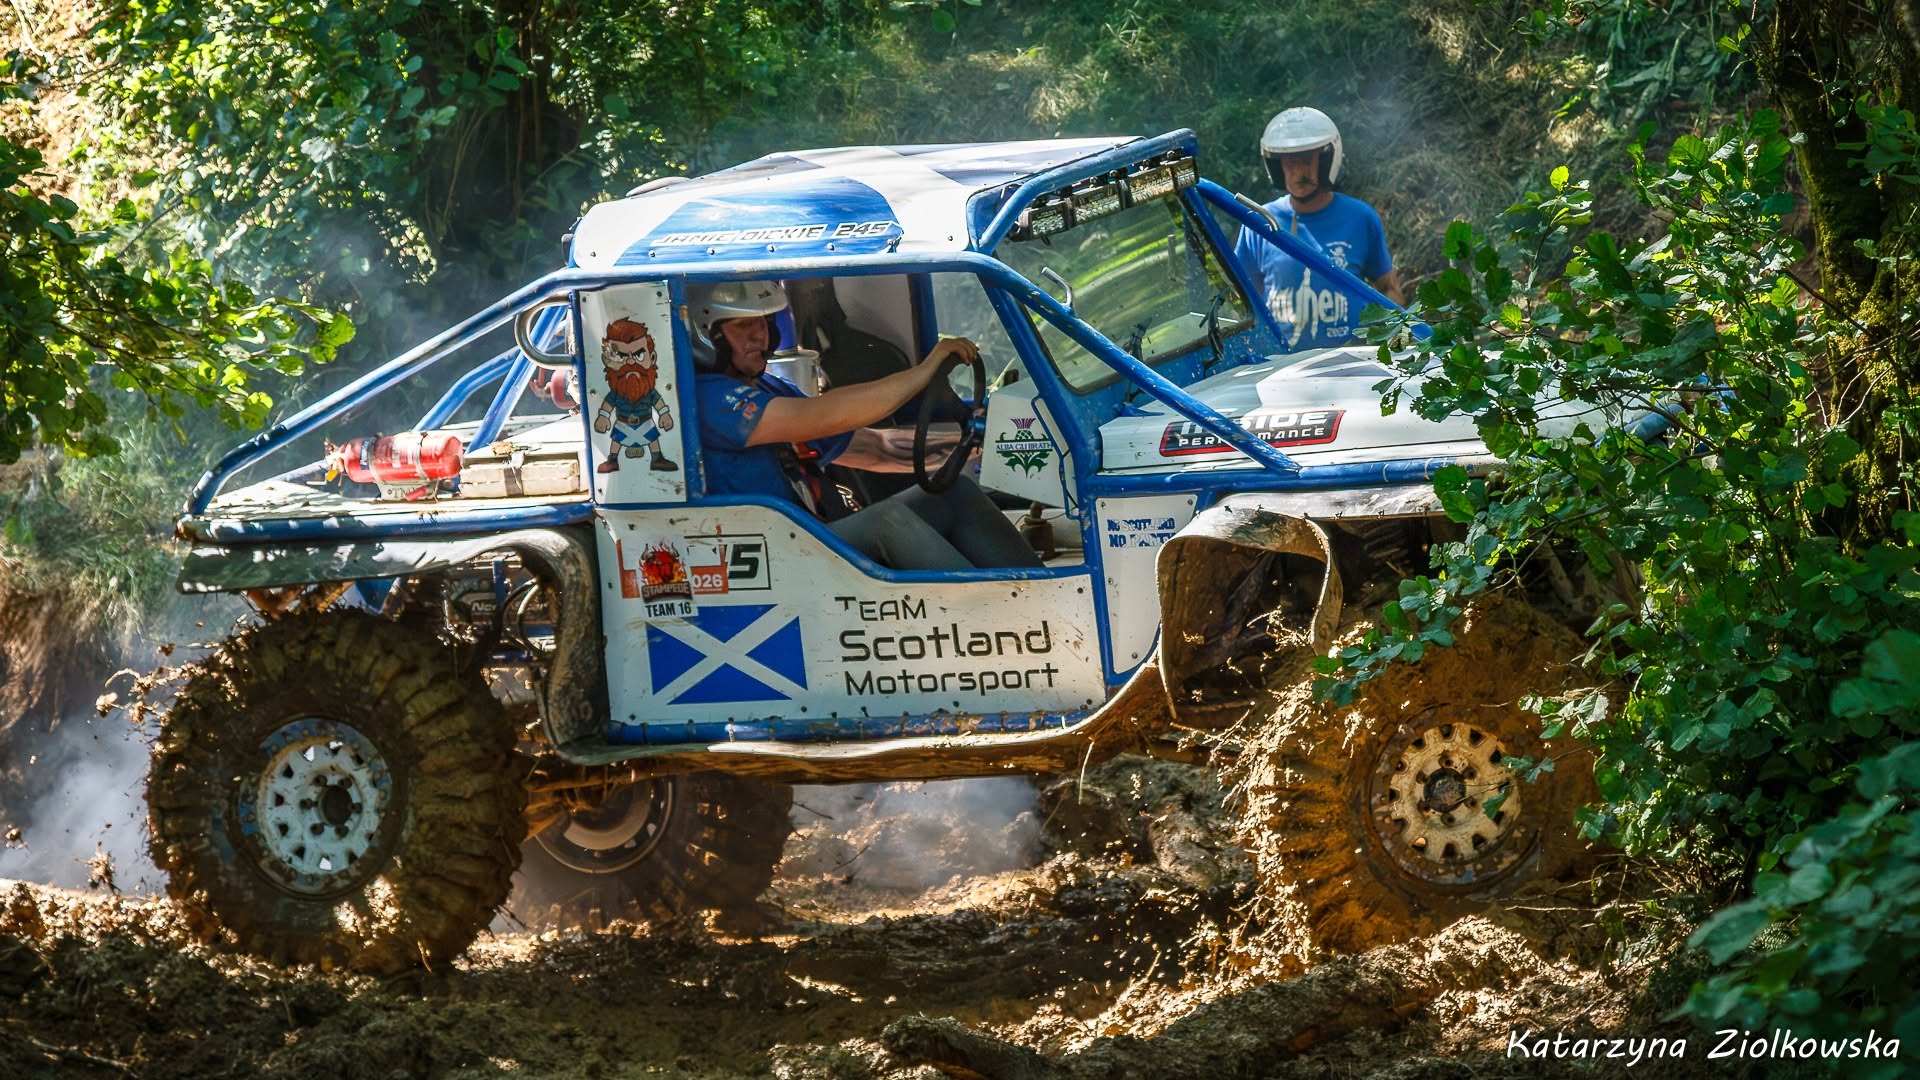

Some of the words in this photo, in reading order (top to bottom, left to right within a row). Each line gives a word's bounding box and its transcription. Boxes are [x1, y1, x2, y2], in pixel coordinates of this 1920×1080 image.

[739, 225, 826, 243] DICKIE
[835, 222, 891, 239] 245
[1181, 412, 1329, 436] ISIDE
[1178, 427, 1325, 447] PERMANCE
[1107, 518, 1121, 532] NO
[1122, 517, 1176, 531] SCOTLAND
[1108, 533, 1127, 547] NO
[642, 582, 691, 600] STAMPEDE
[645, 604, 676, 618] TEAM
[677, 601, 692, 615] 16
[834, 596, 927, 622] TEAM
[839, 620, 1052, 662] Scotland
[844, 662, 1059, 696] Motorsport
